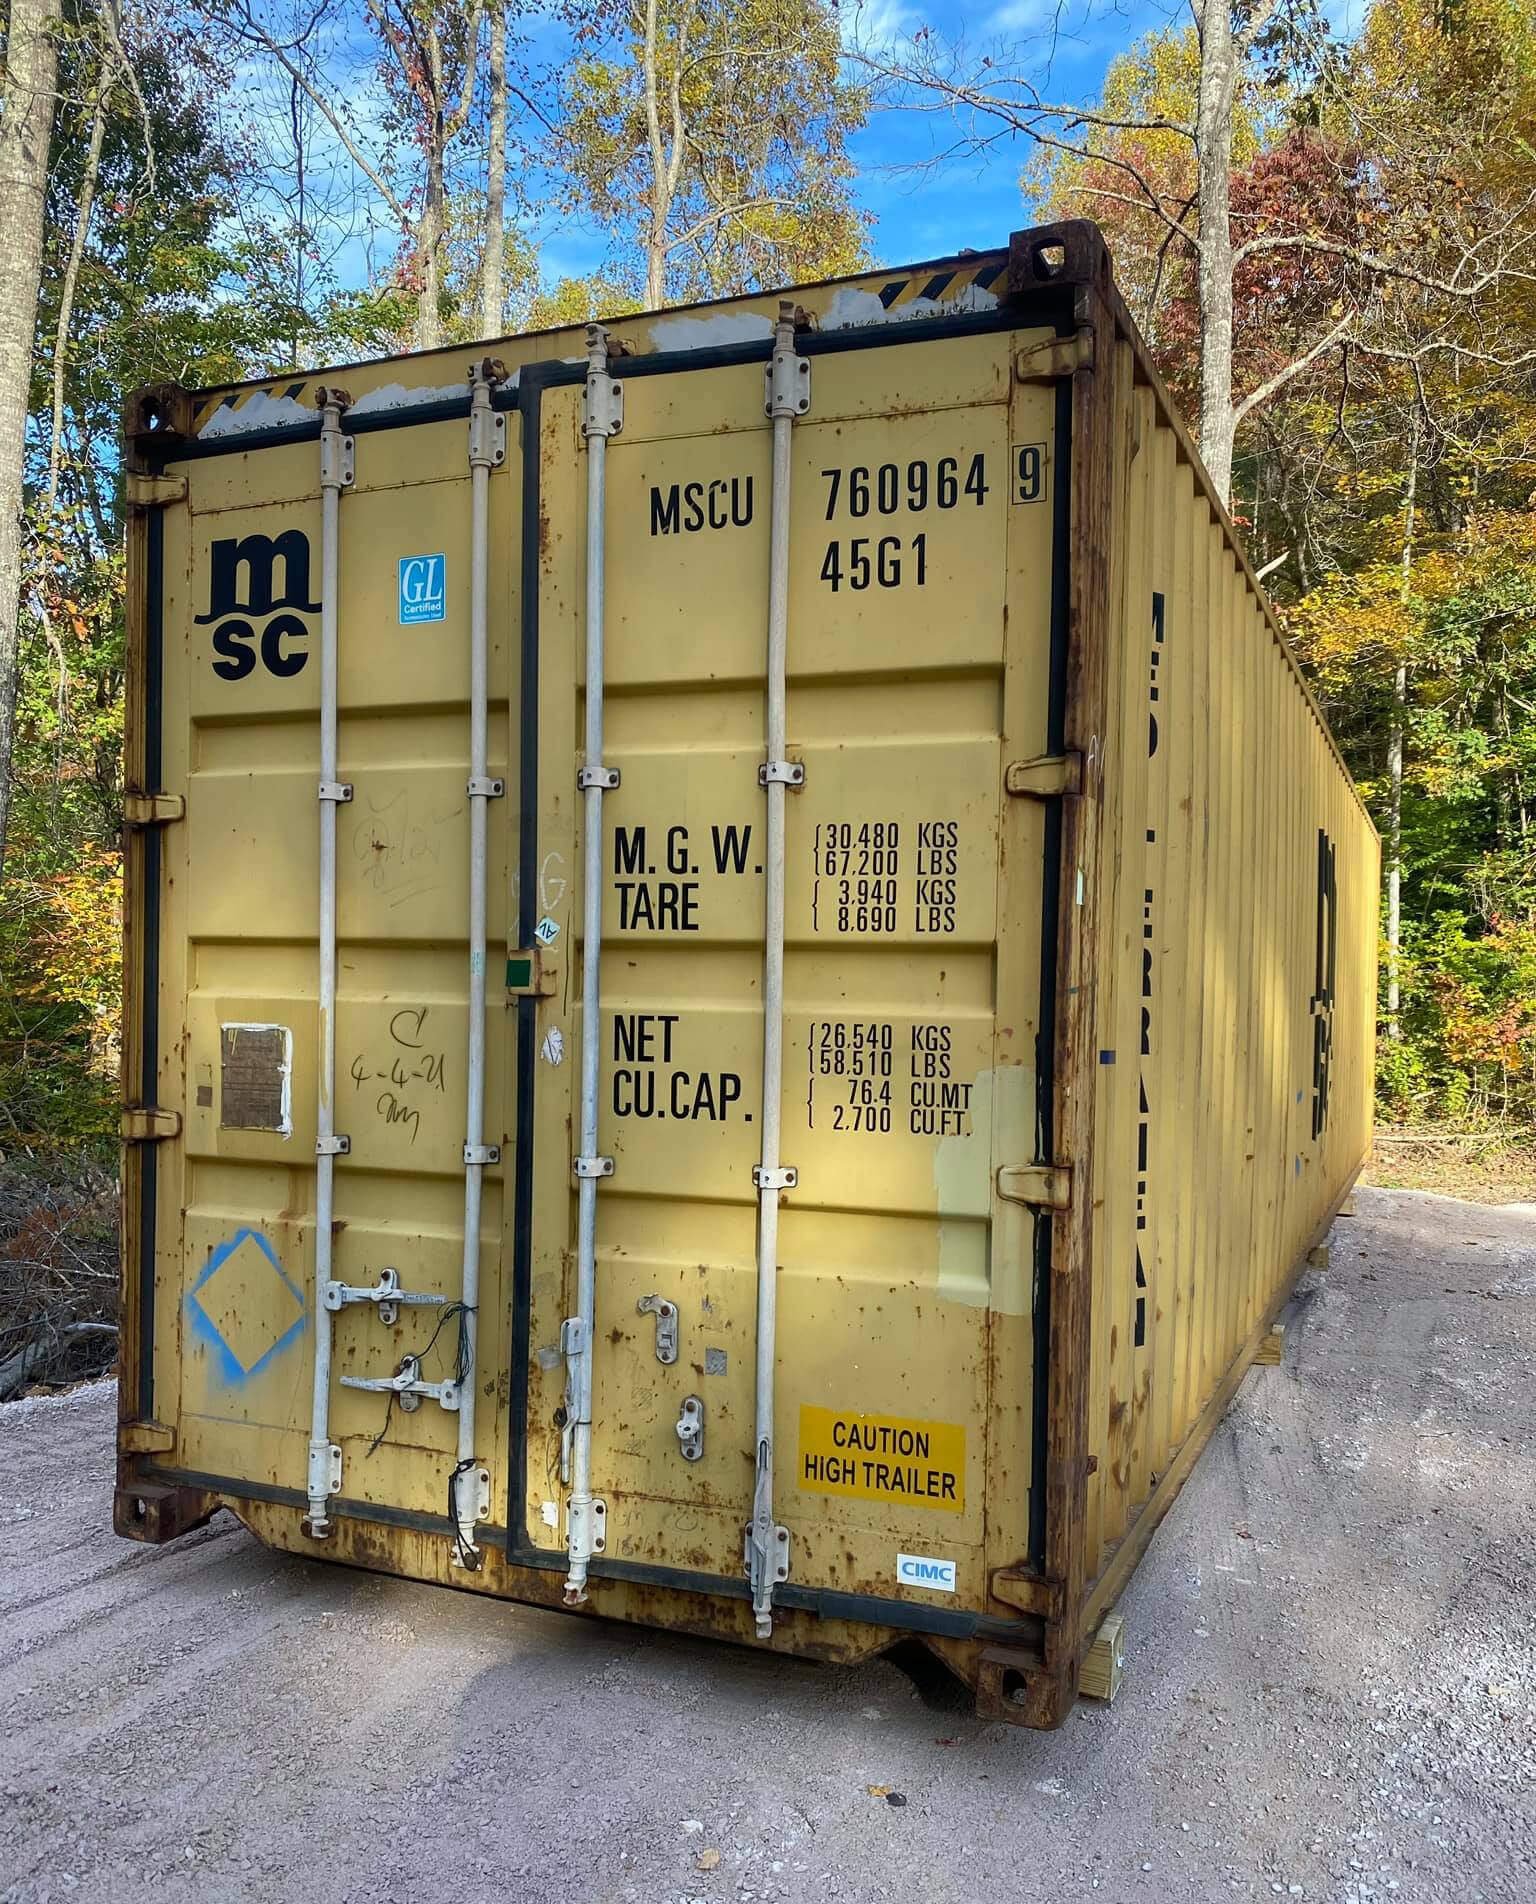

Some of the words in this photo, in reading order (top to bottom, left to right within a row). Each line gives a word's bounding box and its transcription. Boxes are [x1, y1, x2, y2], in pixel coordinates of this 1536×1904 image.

[650, 475, 753, 537] MSCU
[821, 453, 990, 521] 760964
[1018, 447, 1041, 501] 9
[820, 533, 926, 593] 45G1
[402, 559, 442, 603] GL
[404, 602, 441, 613] Certified
[826, 822, 899, 849] 30,480
[918, 821, 958, 849] KGS
[825, 850, 898, 876] 67,200
[917, 849, 957, 876] LBS
[614, 882, 699, 931] TARE
[838, 879, 897, 906] 3,940
[916, 879, 956, 906] KGS
[838, 906, 896, 932] 8,690
[915, 906, 956, 933] LBS
[613, 1014, 680, 1063] NET
[820, 1022, 892, 1050] 26,540
[911, 1025, 951, 1052] KGS
[820, 1049, 892, 1077] 58,510
[911, 1052, 951, 1079] LBS
[848, 1079, 892, 1106] 76.4
[910, 1081, 974, 1110] CU.MT
[833, 1105, 891, 1133] 2,700
[832, 1421, 929, 1459] CAUTION
[804, 1453, 856, 1486] HIGH
[862, 1461, 956, 1500] TRAILER
[902, 1562, 952, 1582] CIMC
